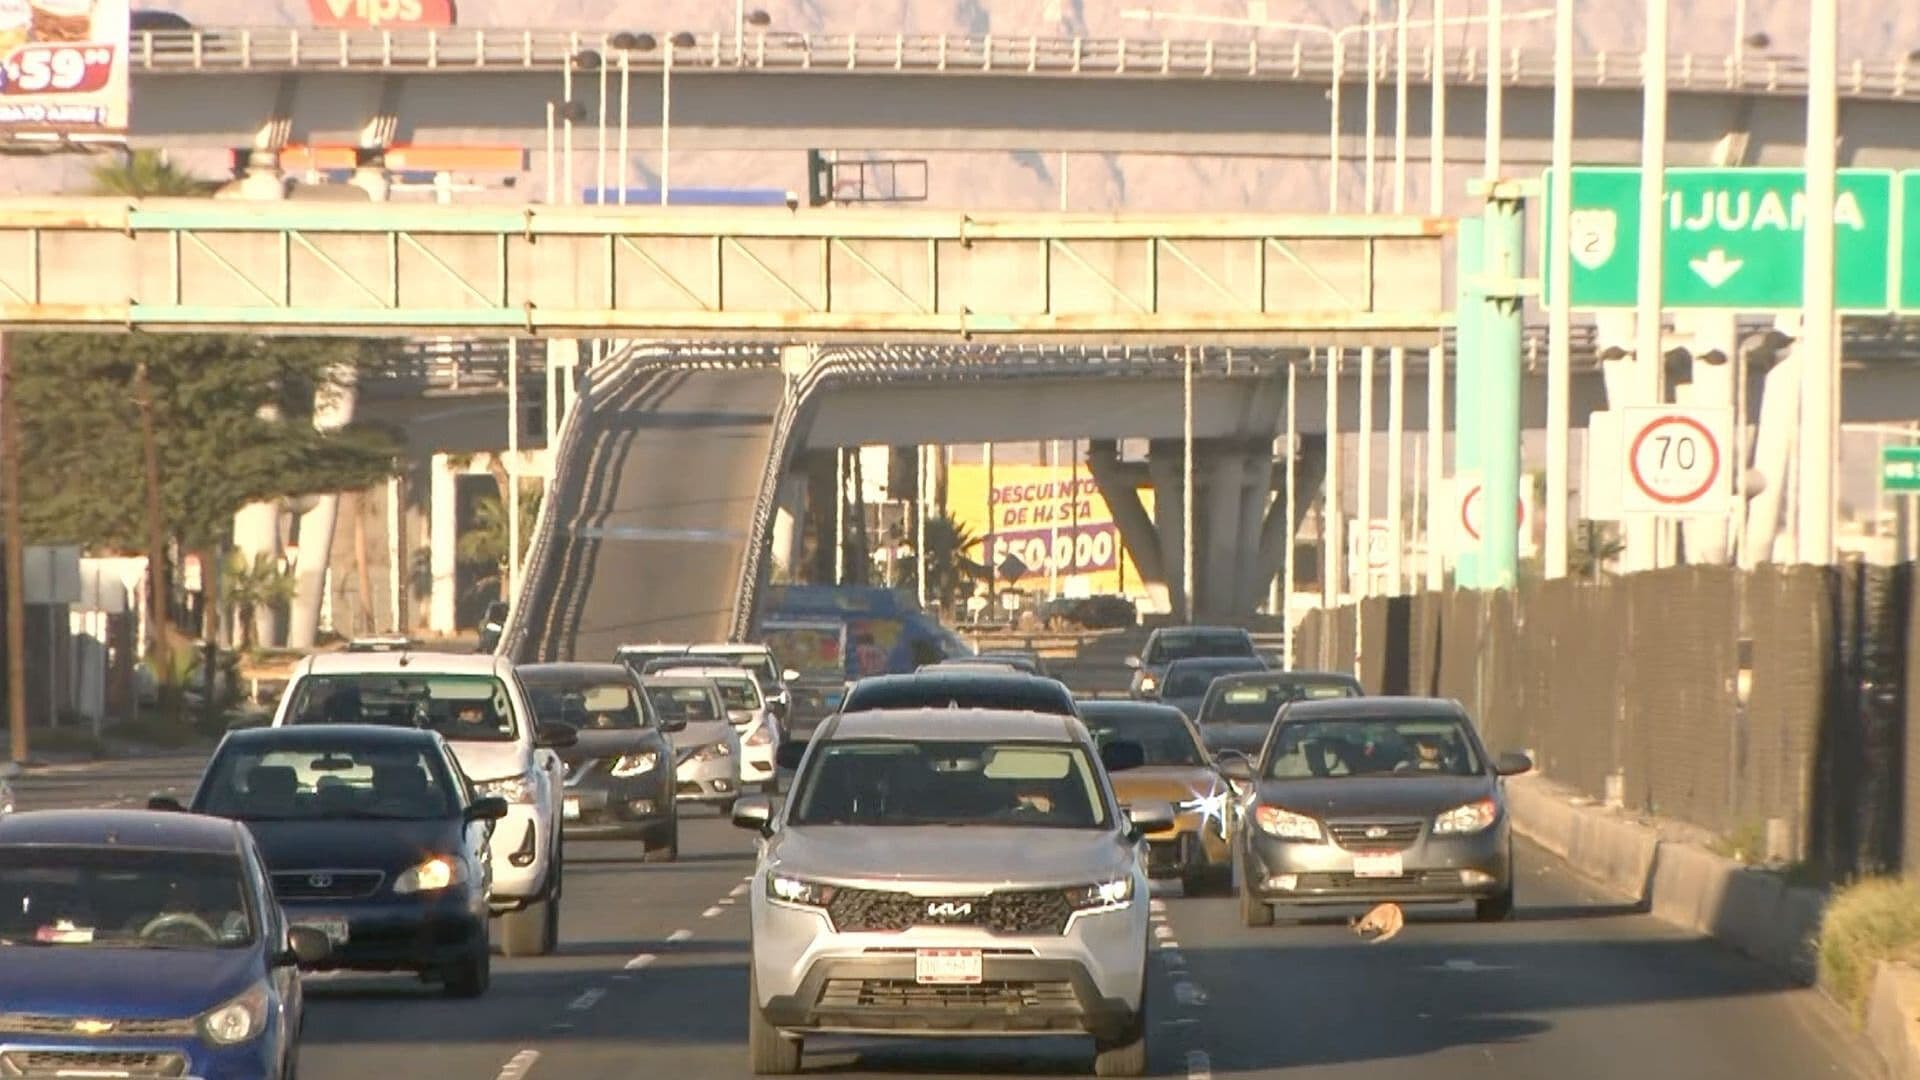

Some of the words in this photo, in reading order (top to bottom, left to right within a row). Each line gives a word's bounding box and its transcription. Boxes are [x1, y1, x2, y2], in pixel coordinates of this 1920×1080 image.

[1663, 191, 1865, 231] IJUAA
[1584, 231, 1601, 253] 2
[1655, 435, 1696, 470] 70
[991, 478, 1099, 505] DESCUENTO
[1003, 507, 1028, 527] DE
